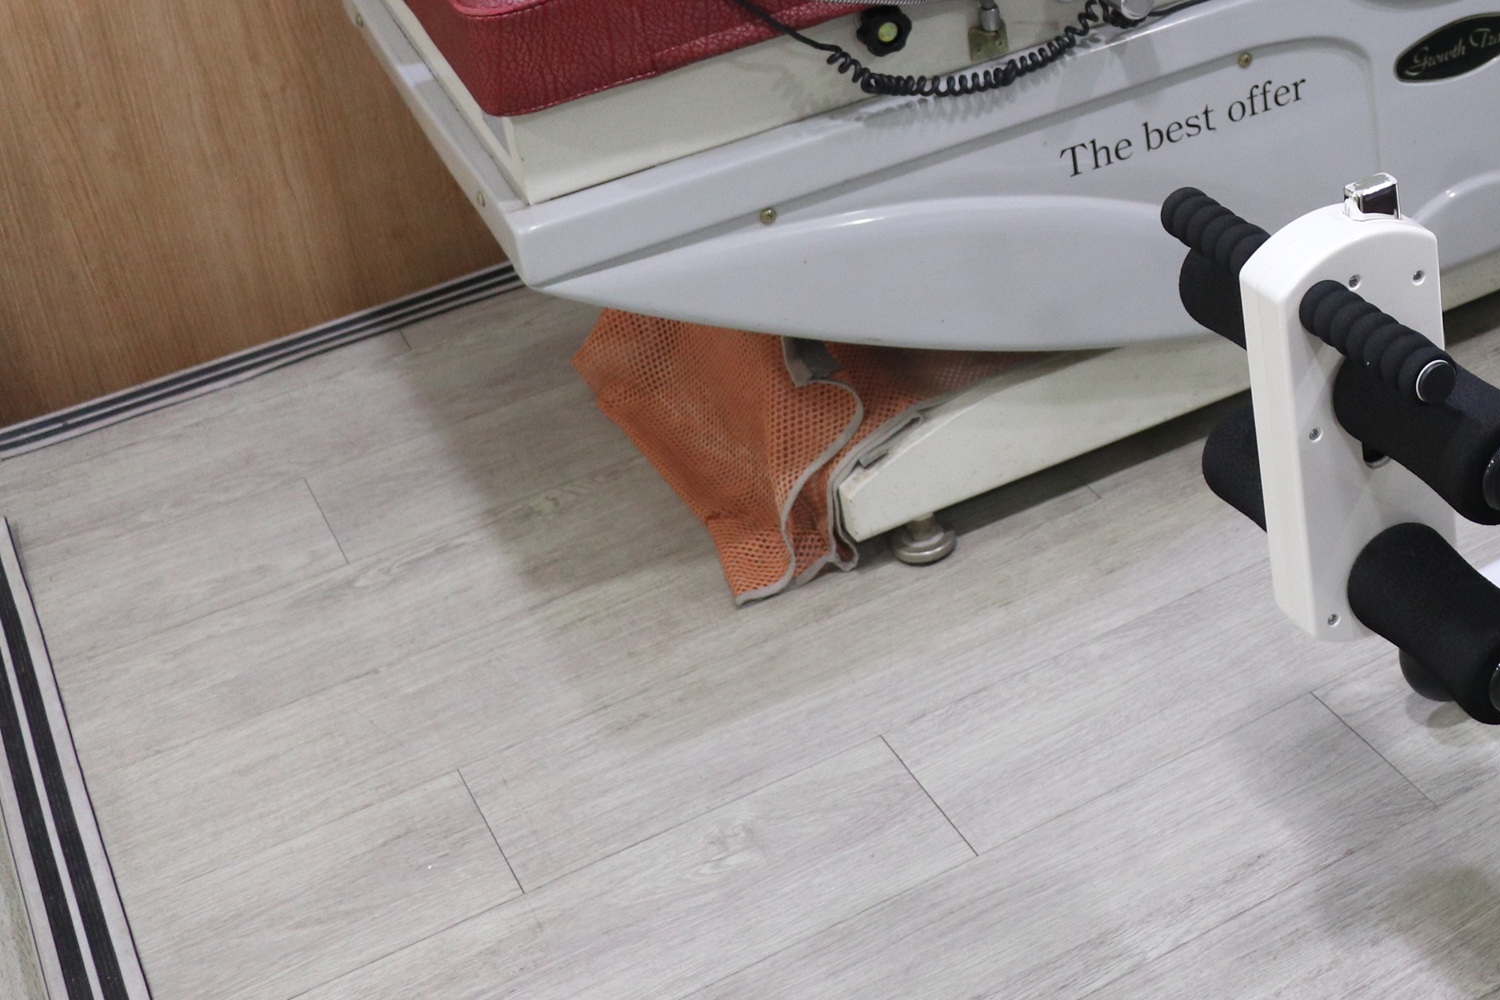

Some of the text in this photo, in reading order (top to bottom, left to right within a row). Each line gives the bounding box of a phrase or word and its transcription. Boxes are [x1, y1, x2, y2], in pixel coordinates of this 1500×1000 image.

[1059, 78, 1306, 178] The best offer
